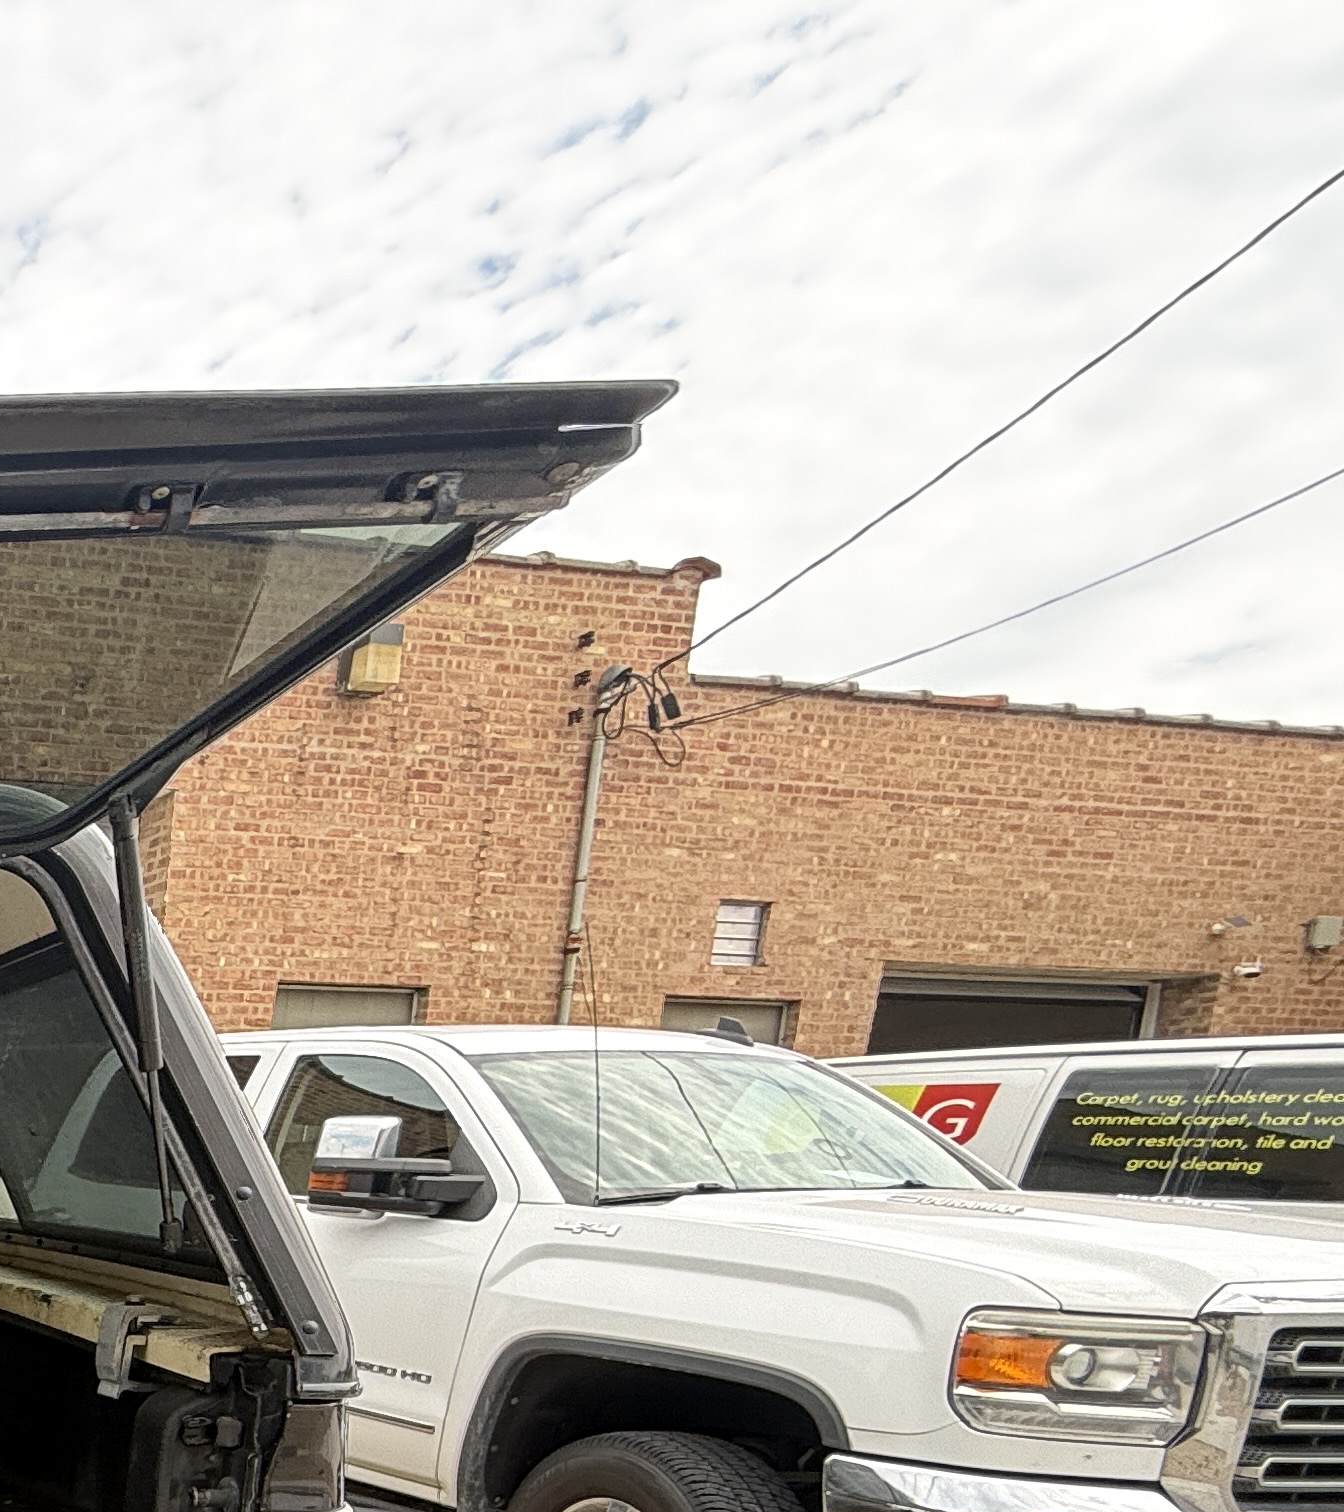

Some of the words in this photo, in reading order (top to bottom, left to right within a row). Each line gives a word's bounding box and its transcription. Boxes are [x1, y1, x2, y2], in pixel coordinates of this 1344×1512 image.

[1076, 1092, 1144, 1107] Carpet,
[1148, 1093, 1189, 1107] rug,
[1193, 1089, 1302, 1107] upholstery
[1072, 1112, 1183, 1126] commercial
[1181, 1113, 1253, 1129] carpet,
[1257, 1111, 1311, 1126] hard
[1090, 1132, 1135, 1147] floor
[1255, 1134, 1287, 1149] tile
[1289, 1135, 1336, 1150] and
[1180, 1156, 1264, 1175] cleaning
